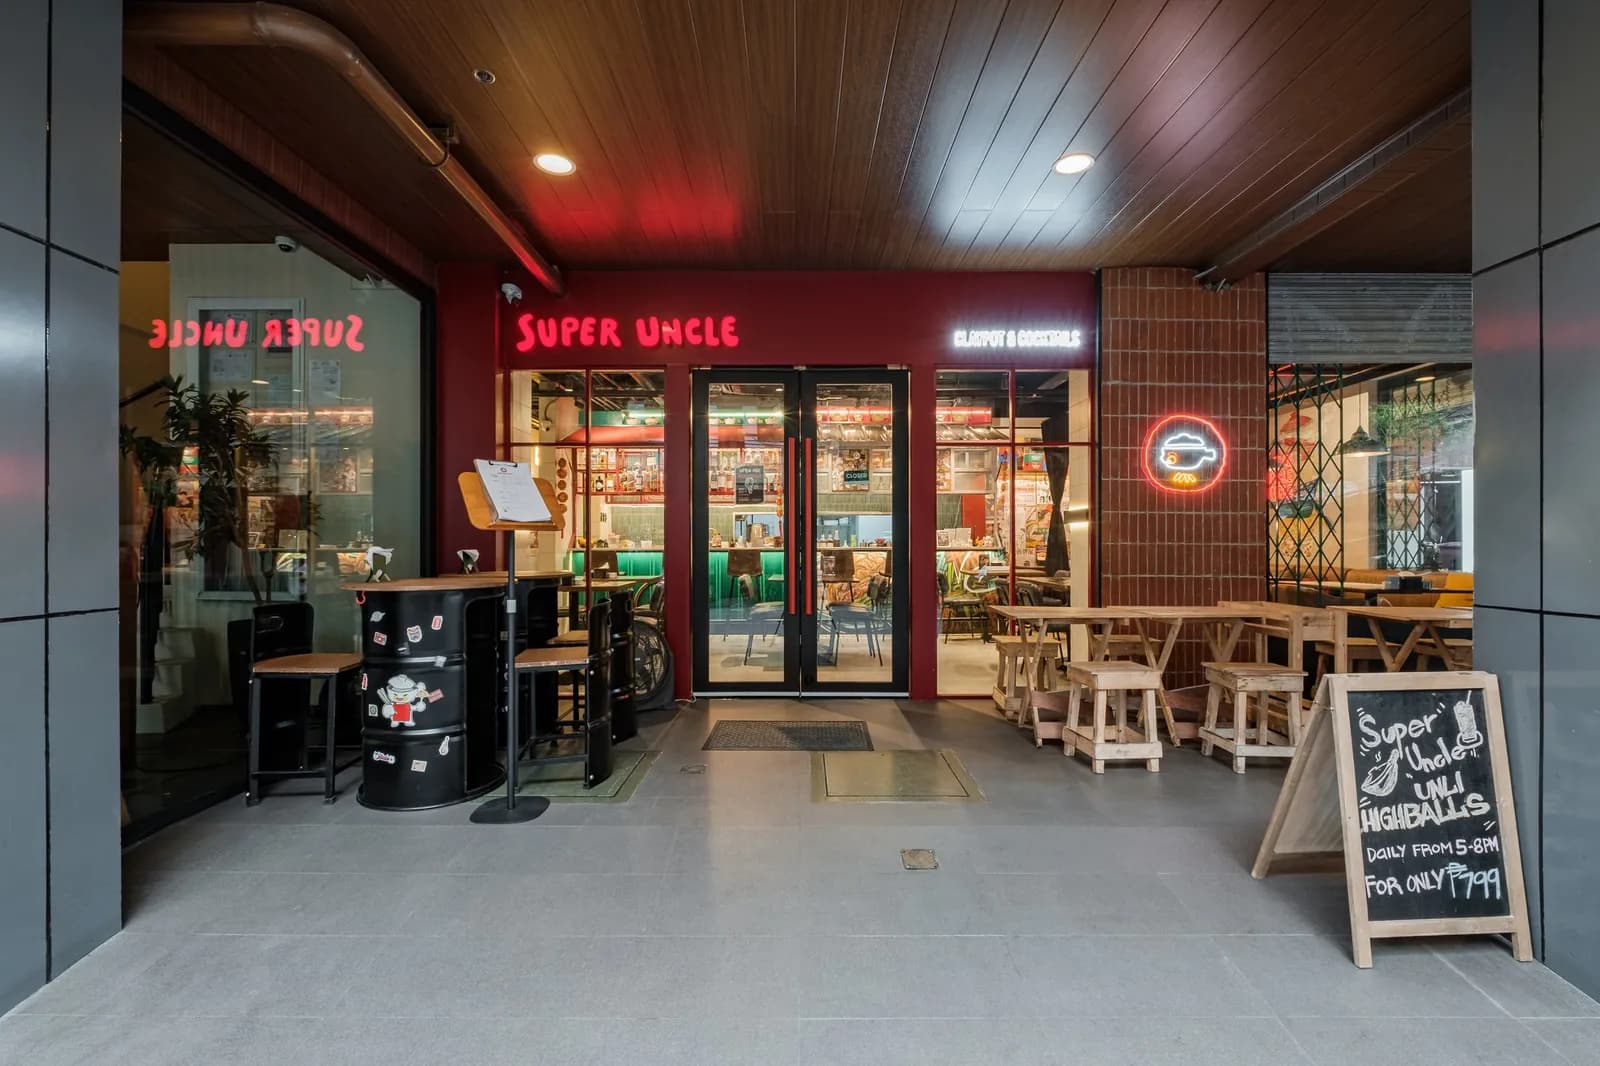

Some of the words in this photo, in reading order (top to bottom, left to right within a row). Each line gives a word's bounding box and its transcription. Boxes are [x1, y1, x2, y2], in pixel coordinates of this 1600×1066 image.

[516, 313, 622, 353] SUPER
[635, 316, 740, 348] UNCLE
[1359, 713, 1438, 759] Super
[1405, 737, 1467, 773] Uncle
[1413, 771, 1464, 801] UNLI
[1360, 793, 1491, 833] HIGHBALLS
[1364, 874, 1403, 898] FOR
[1406, 868, 1445, 893] ONLY
